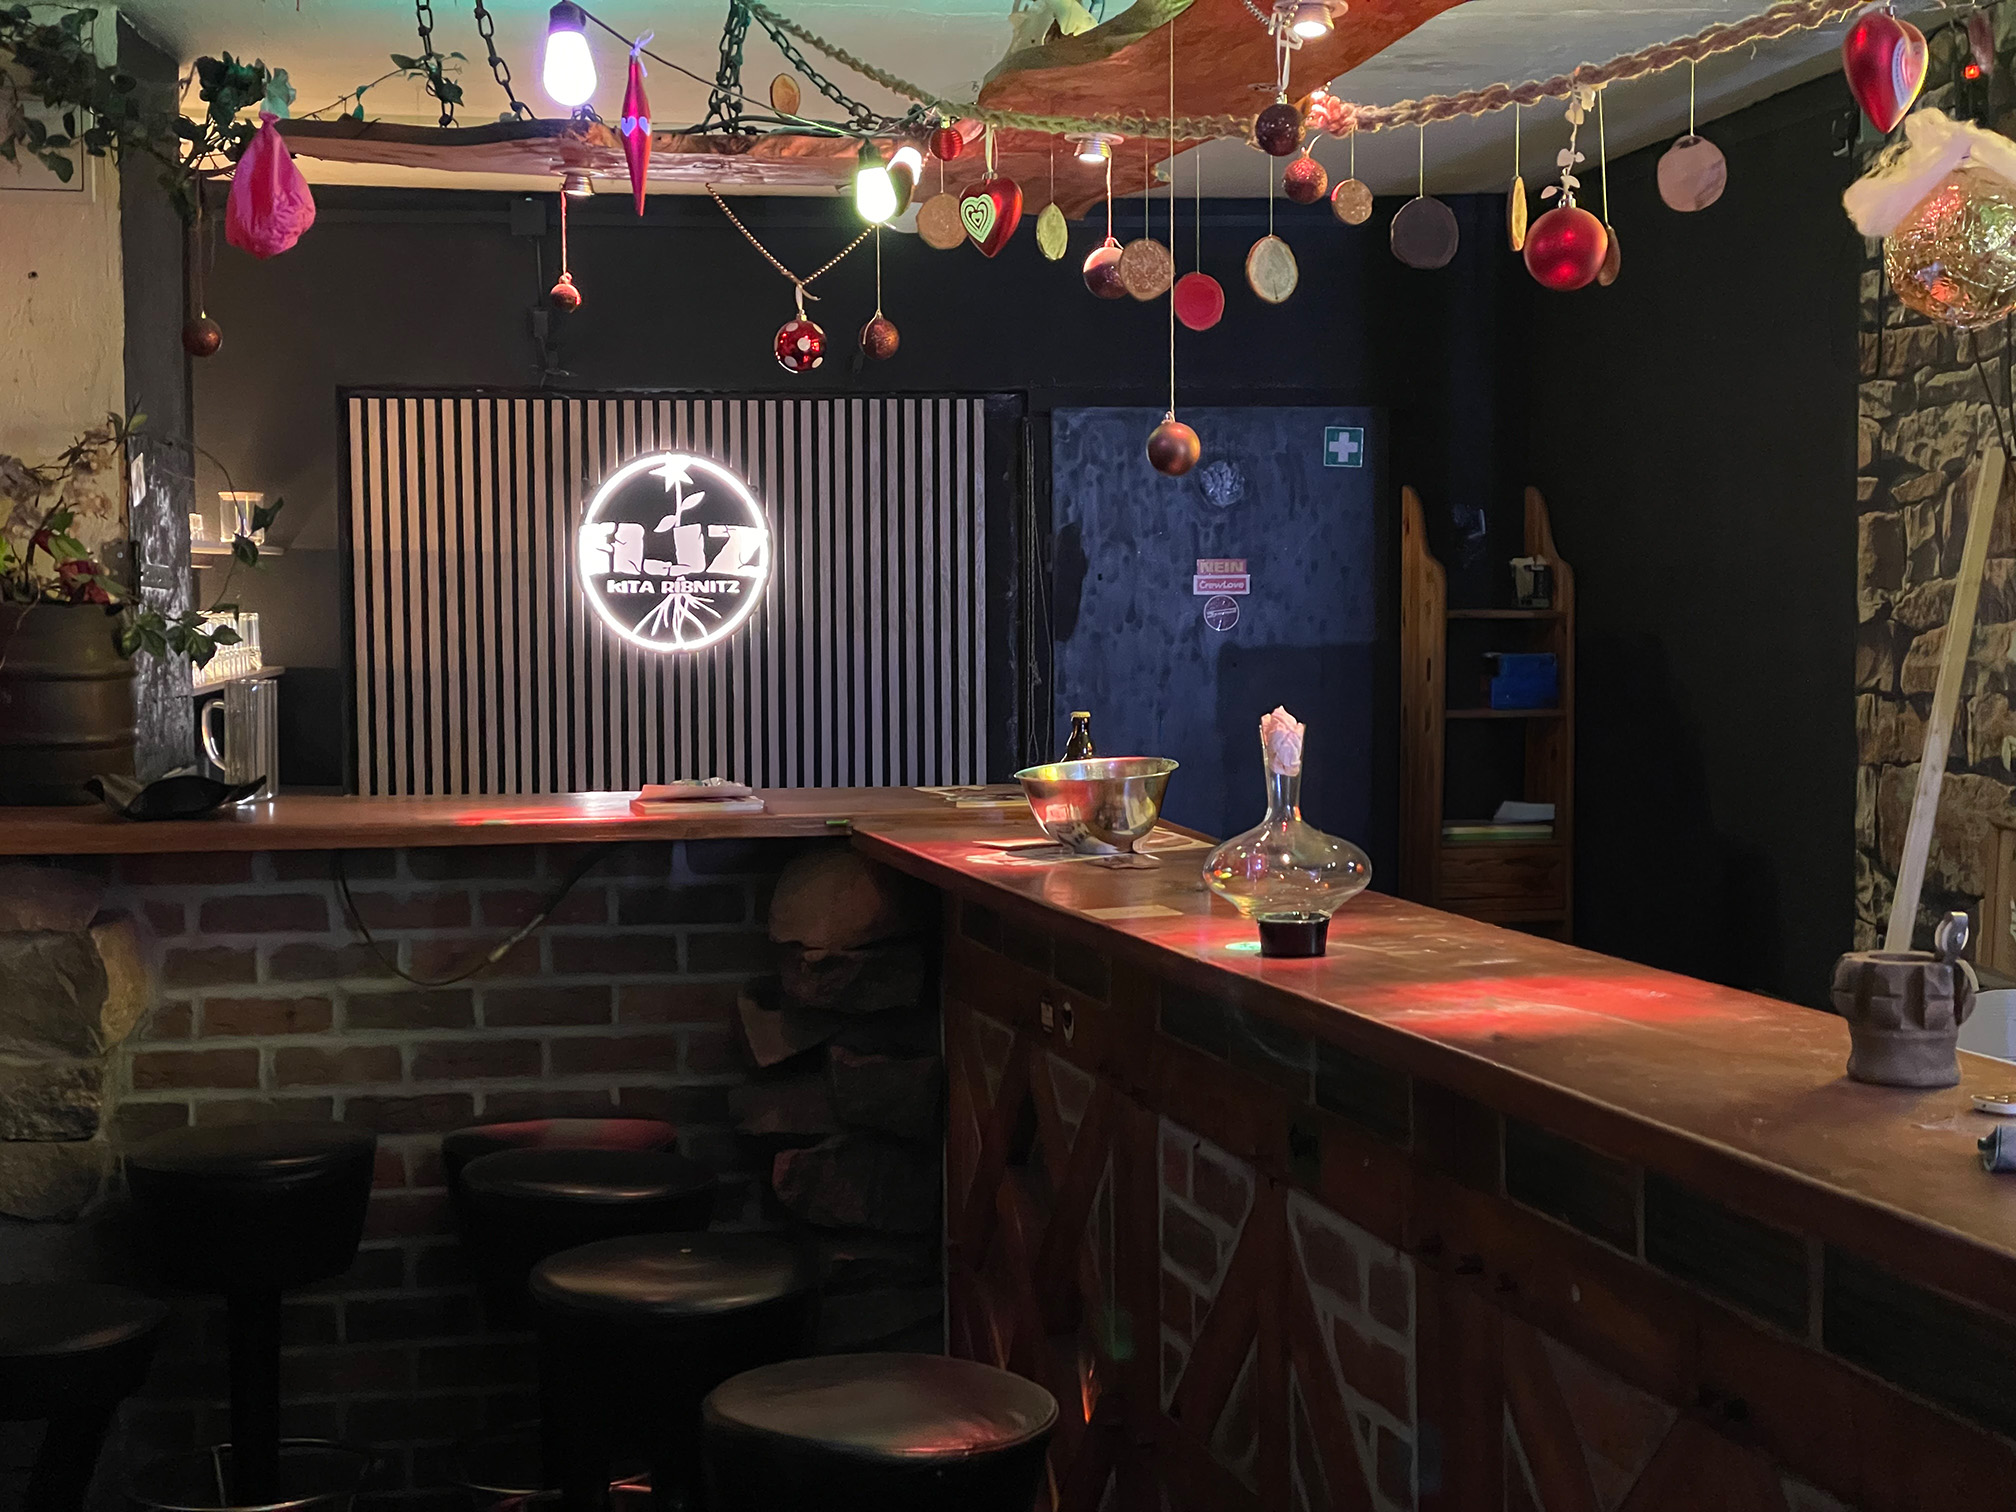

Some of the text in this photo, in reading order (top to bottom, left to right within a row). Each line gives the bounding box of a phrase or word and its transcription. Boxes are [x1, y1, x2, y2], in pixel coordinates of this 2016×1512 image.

[1199, 561, 1244, 573] NEIN
[606, 579, 741, 594] KITA RIBNITZ
